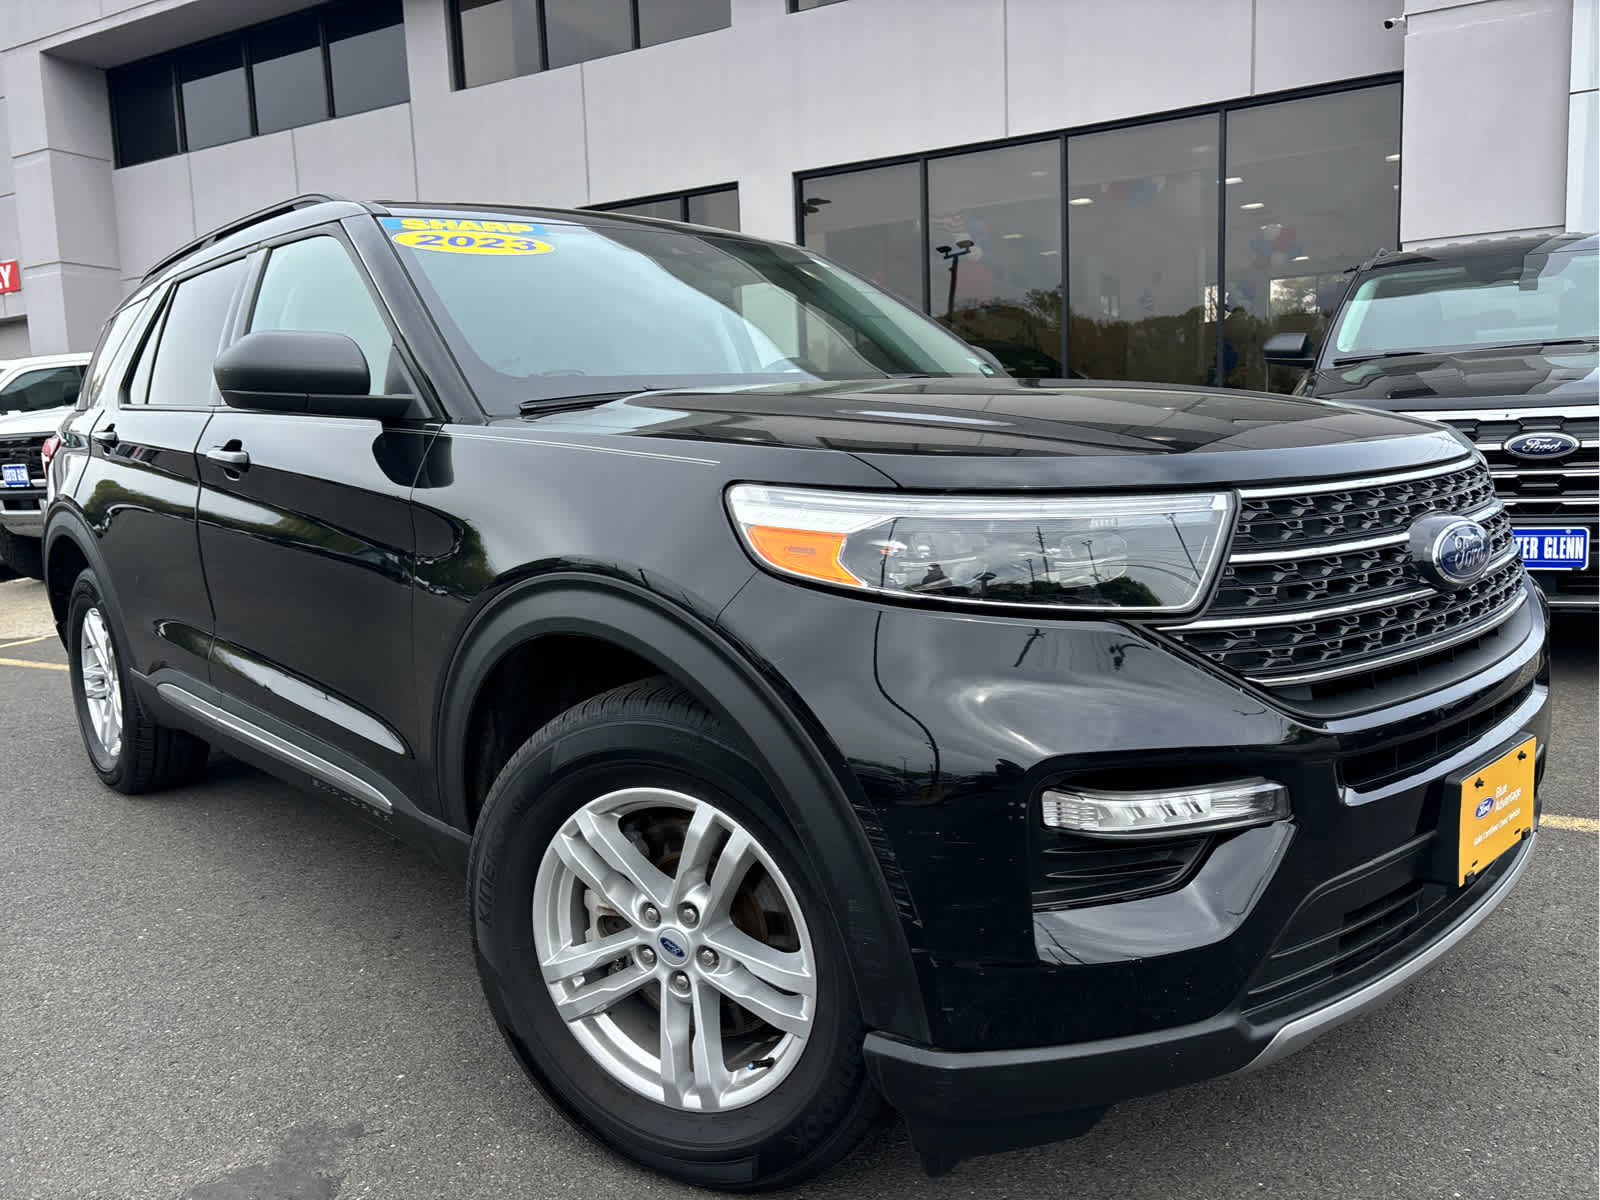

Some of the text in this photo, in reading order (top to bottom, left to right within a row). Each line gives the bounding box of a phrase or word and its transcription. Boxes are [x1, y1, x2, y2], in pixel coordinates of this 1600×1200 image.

[400, 218, 534, 233] SHARP
[415, 234, 537, 251] 2023
[1522, 437, 1562, 453] Ford
[1514, 536, 1584, 560] TER GLENN
